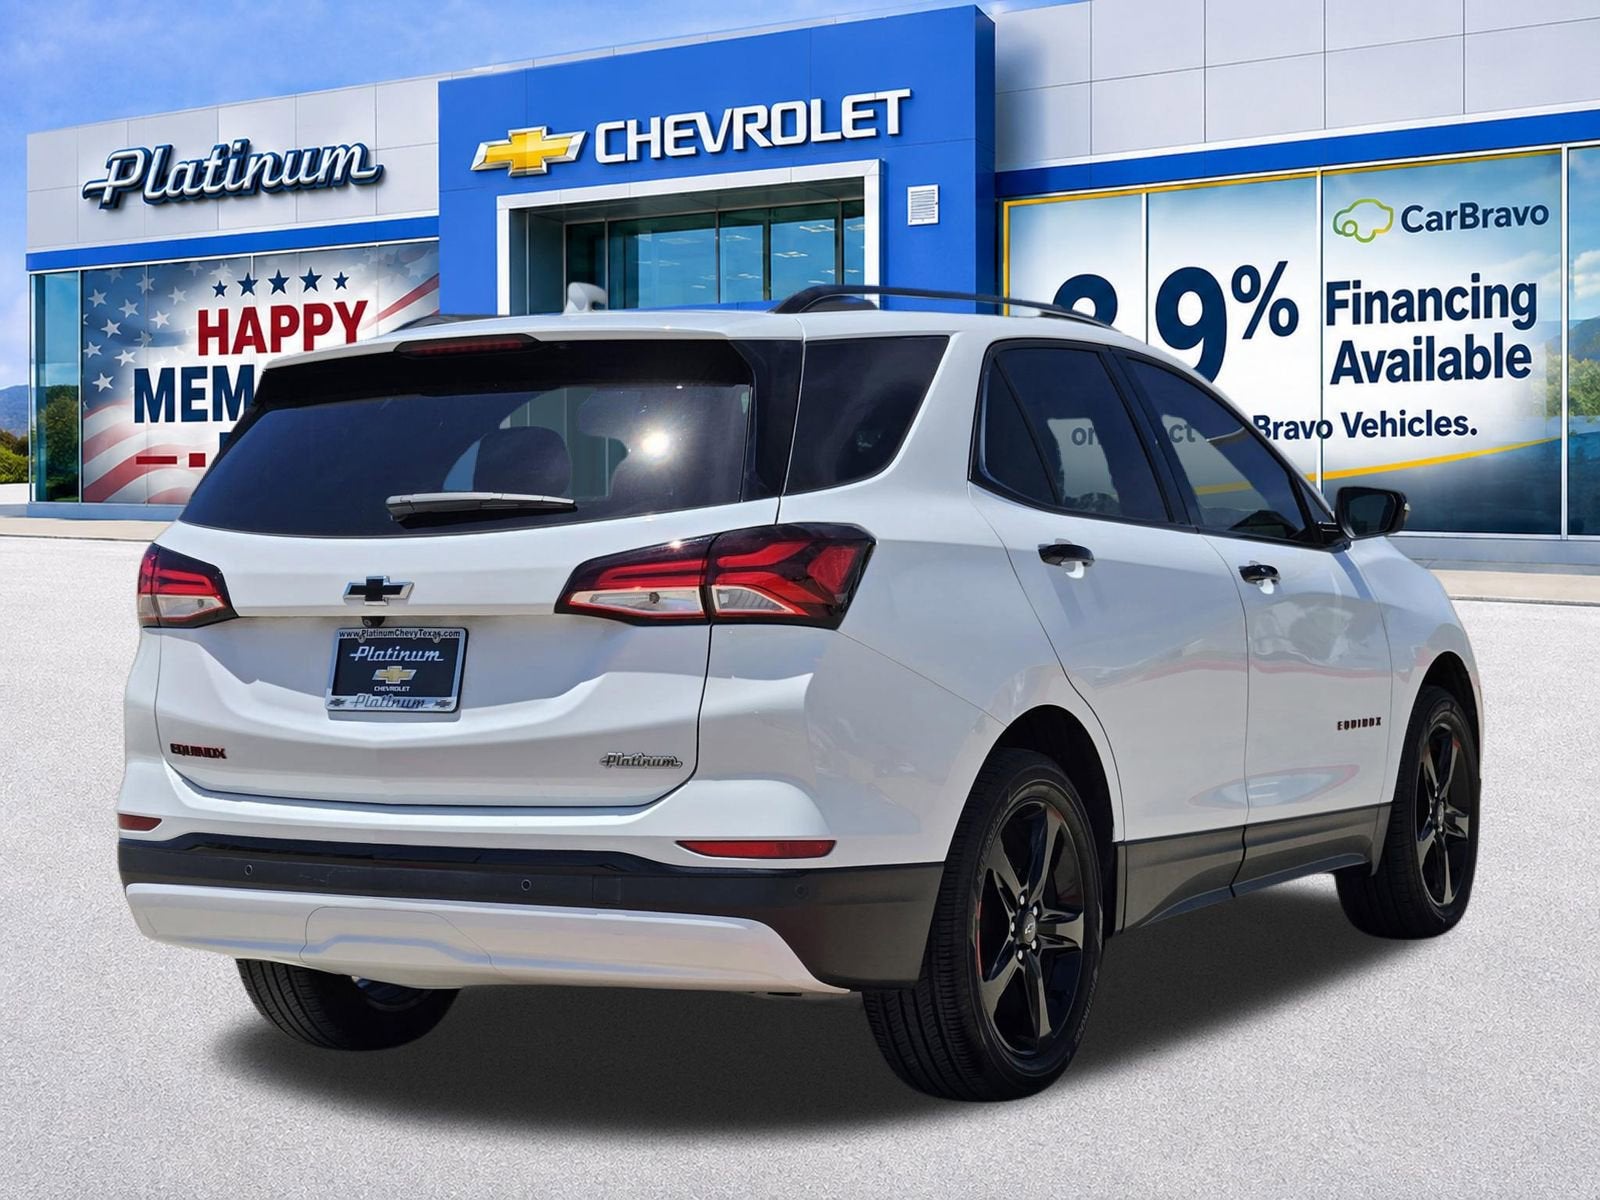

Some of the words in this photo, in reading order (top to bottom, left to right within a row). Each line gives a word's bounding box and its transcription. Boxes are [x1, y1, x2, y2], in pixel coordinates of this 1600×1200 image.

[595, 88, 911, 164] CHEVROLET
[82, 138, 384, 209] Platinum
[1401, 201, 1549, 234] CarBravo
[1326, 273, 1538, 330] Financing
[198, 300, 368, 356] HAPPY
[1330, 332, 1532, 385] Available
[1341, 409, 1478, 439] Vehicles.
[350, 646, 443, 662] Platinum
[350, 694, 431, 708] Platinum
[170, 743, 227, 759] EQUINOX
[600, 752, 682, 768] Platinum
